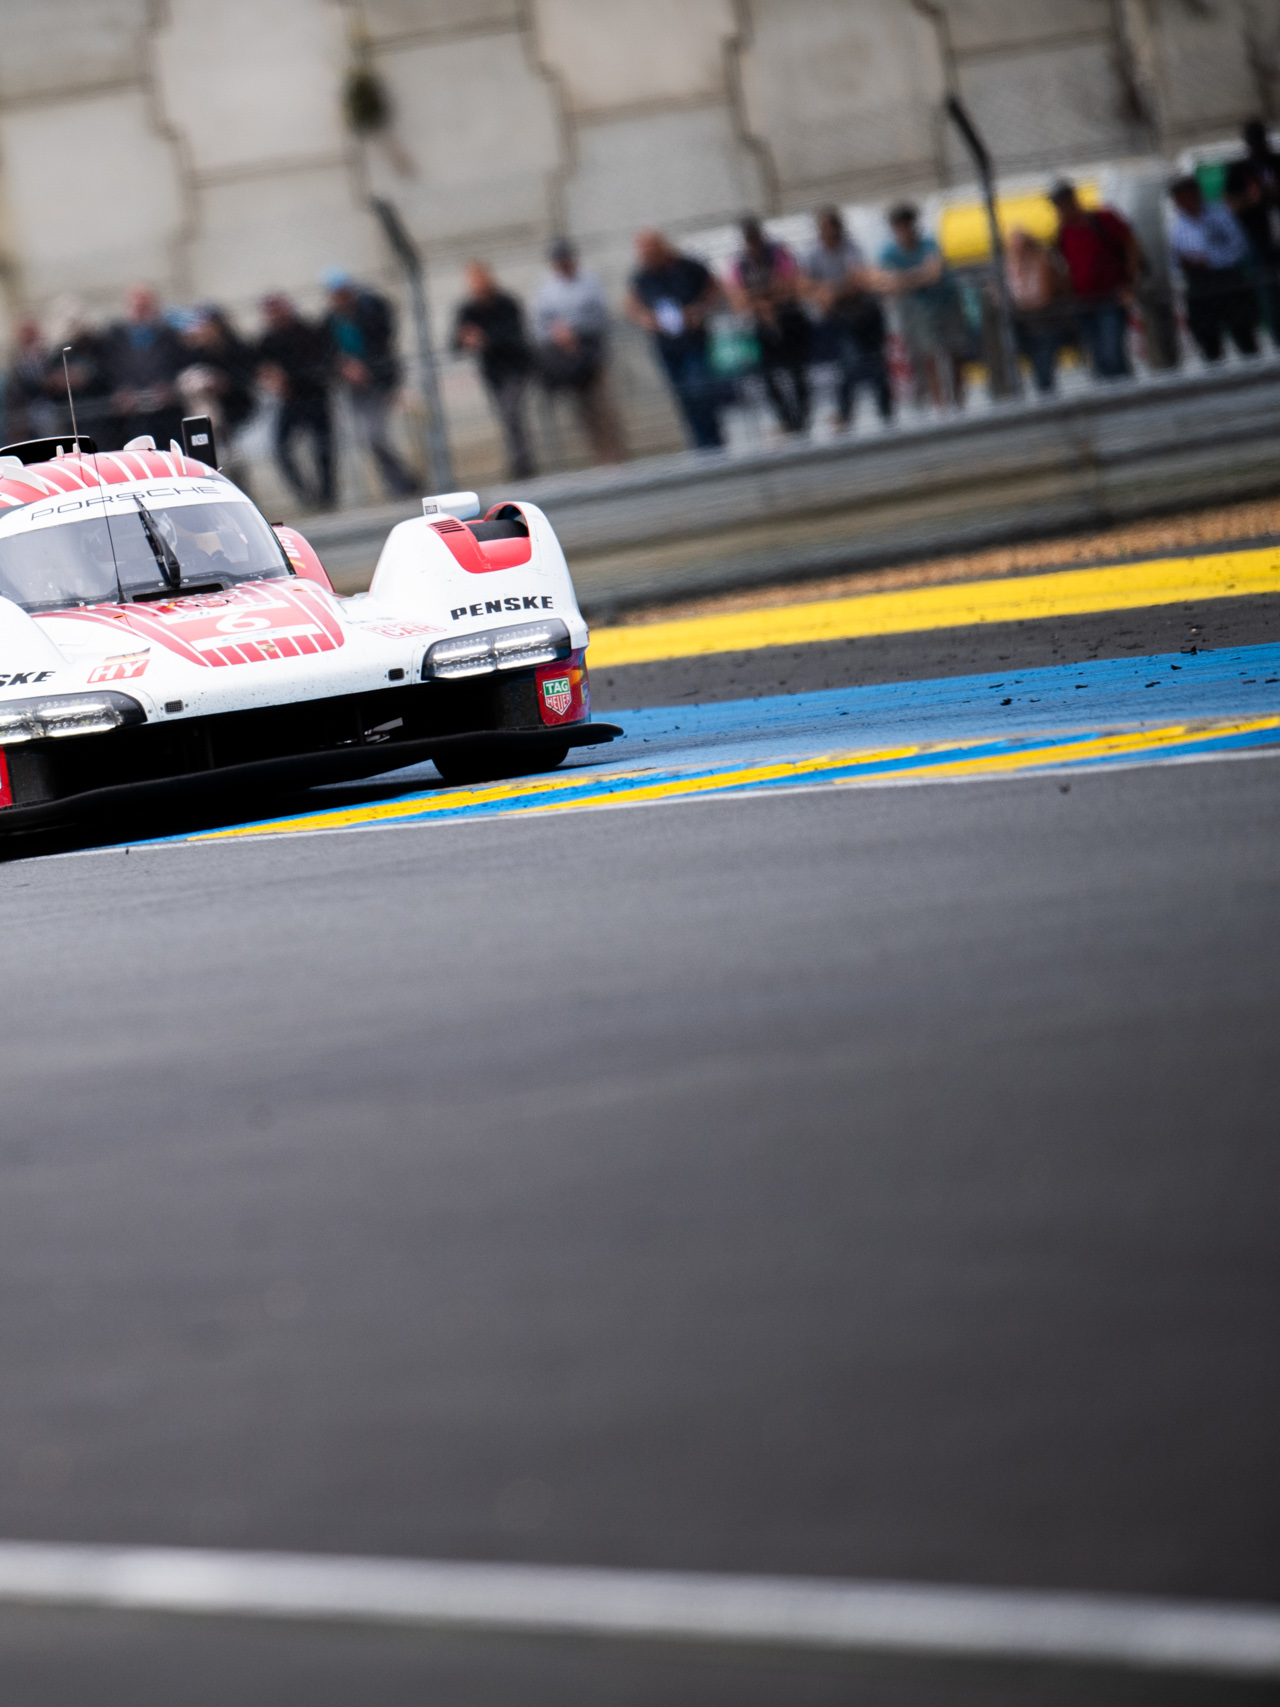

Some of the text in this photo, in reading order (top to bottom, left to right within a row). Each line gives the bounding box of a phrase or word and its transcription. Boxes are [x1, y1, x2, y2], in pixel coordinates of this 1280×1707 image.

[31, 486, 221, 521] PORSCHE
[450, 596, 554, 620] PENSKE
[215, 611, 271, 633] 6
[89, 660, 144, 683] HY
[546, 681, 568, 694] TAG
[546, 695, 570, 713] HEUER
